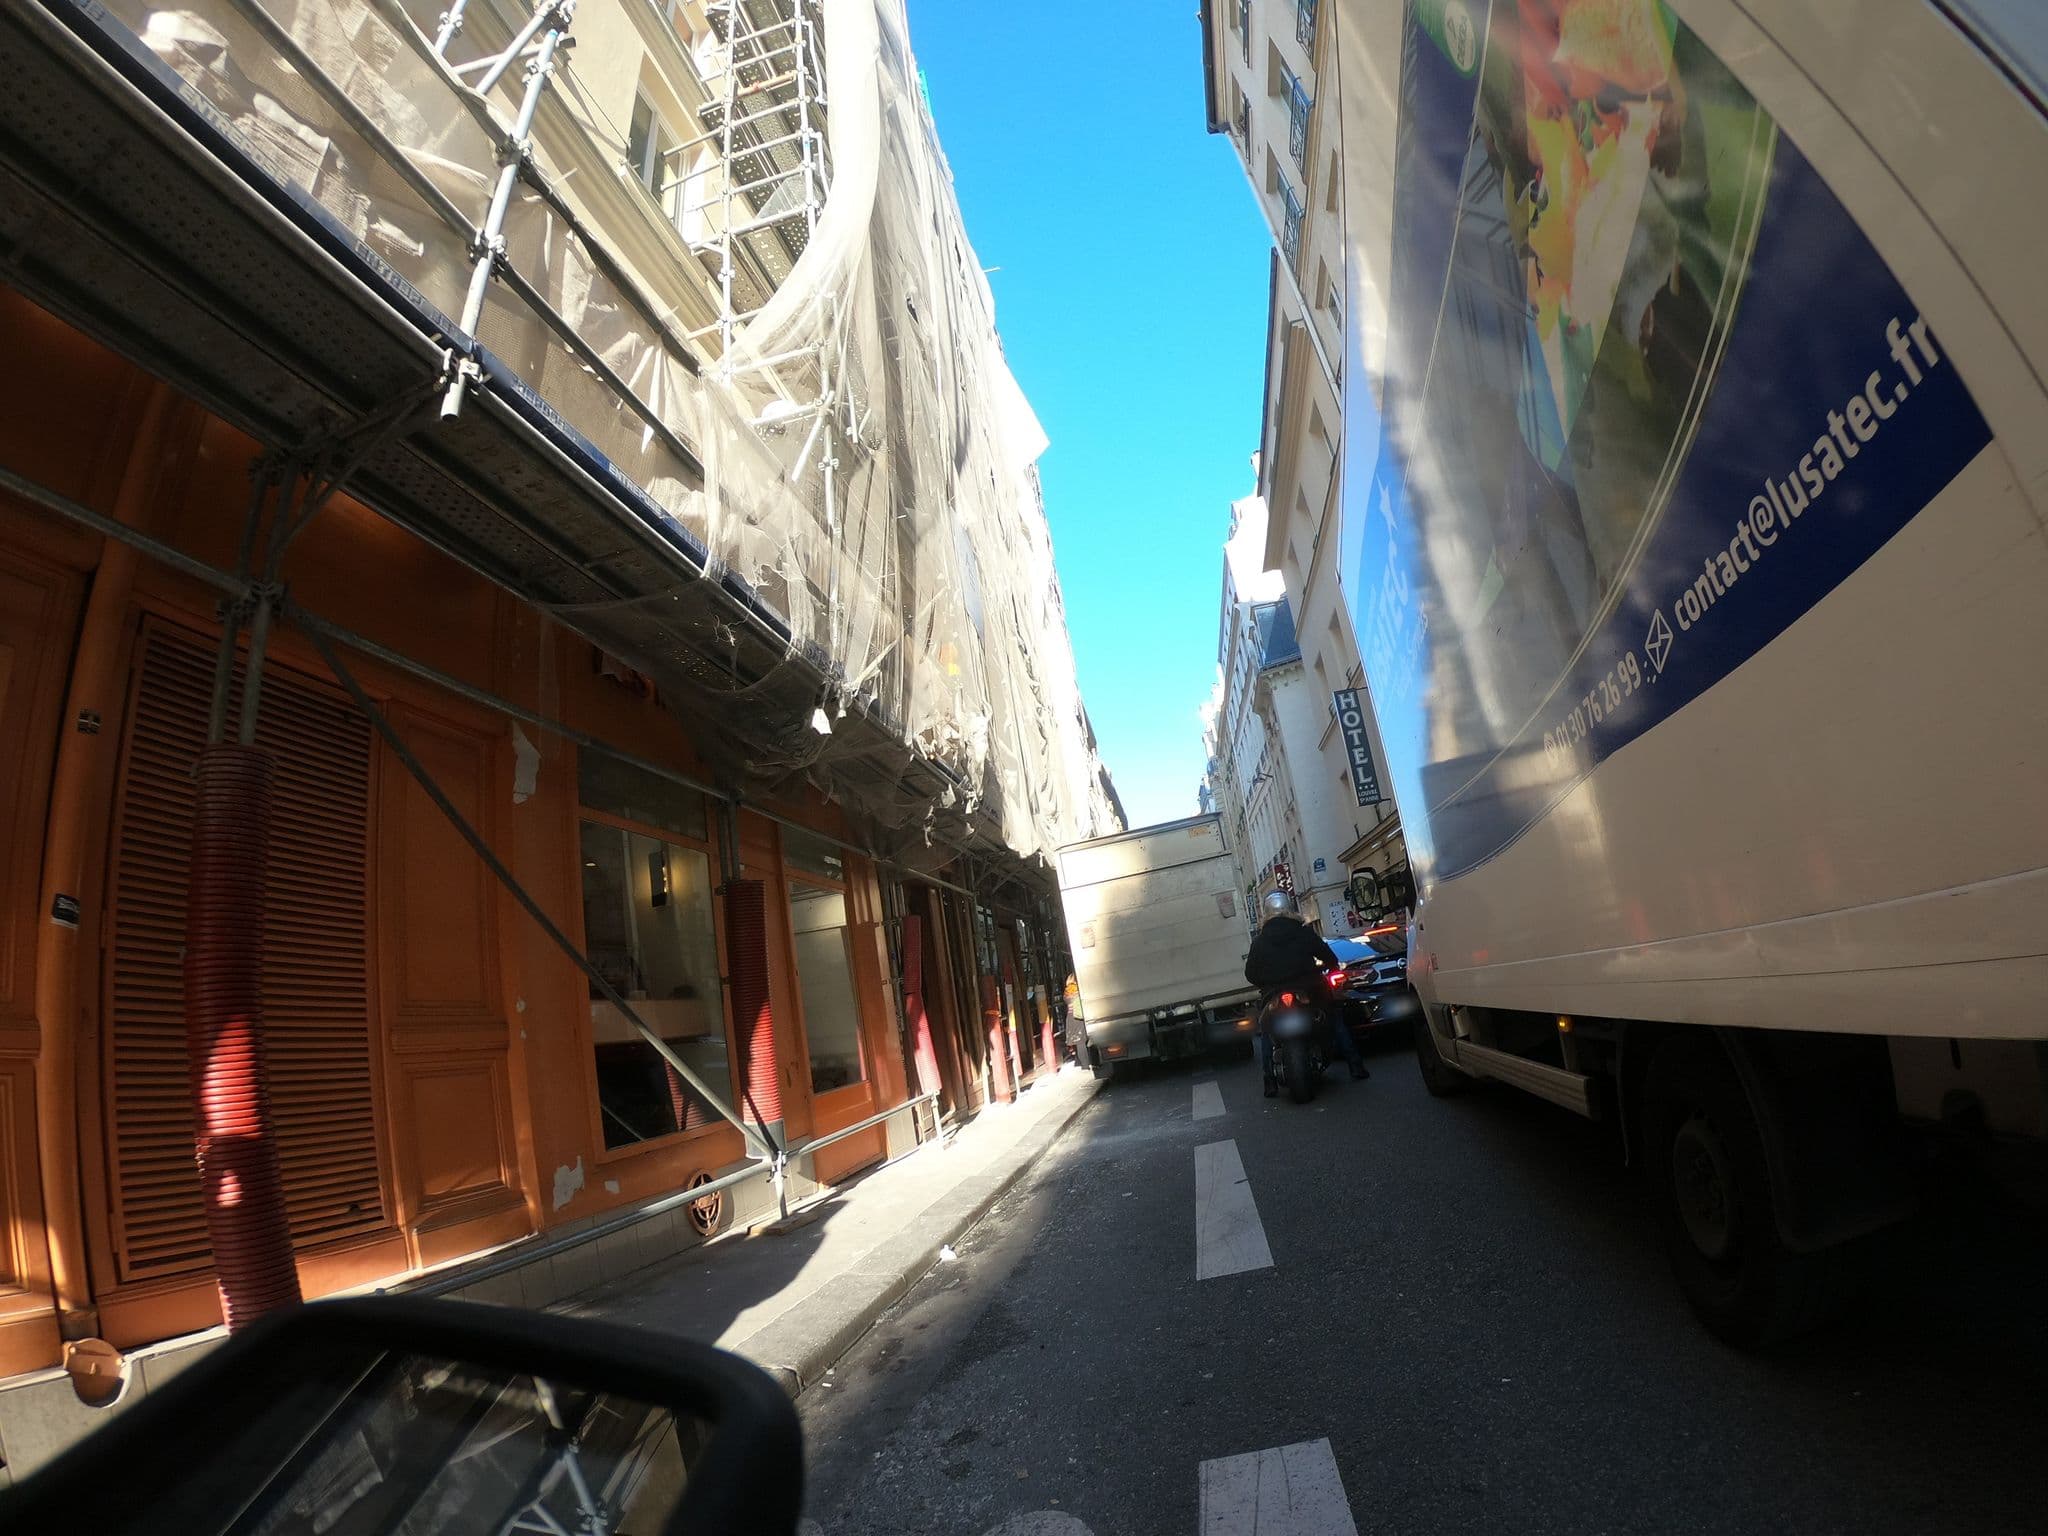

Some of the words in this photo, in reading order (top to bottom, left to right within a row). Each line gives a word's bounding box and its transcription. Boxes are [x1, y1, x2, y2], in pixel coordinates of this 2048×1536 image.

[1674, 311, 1939, 632] contact@lusatec.fr
[1338, 692, 1374, 784] HOTEL
[1556, 721, 1572, 751] 01
[1568, 706, 1586, 743] 30
[1582, 690, 1603, 729] 76
[1598, 671, 1621, 715] 26
[1617, 651, 1641, 697] 99
